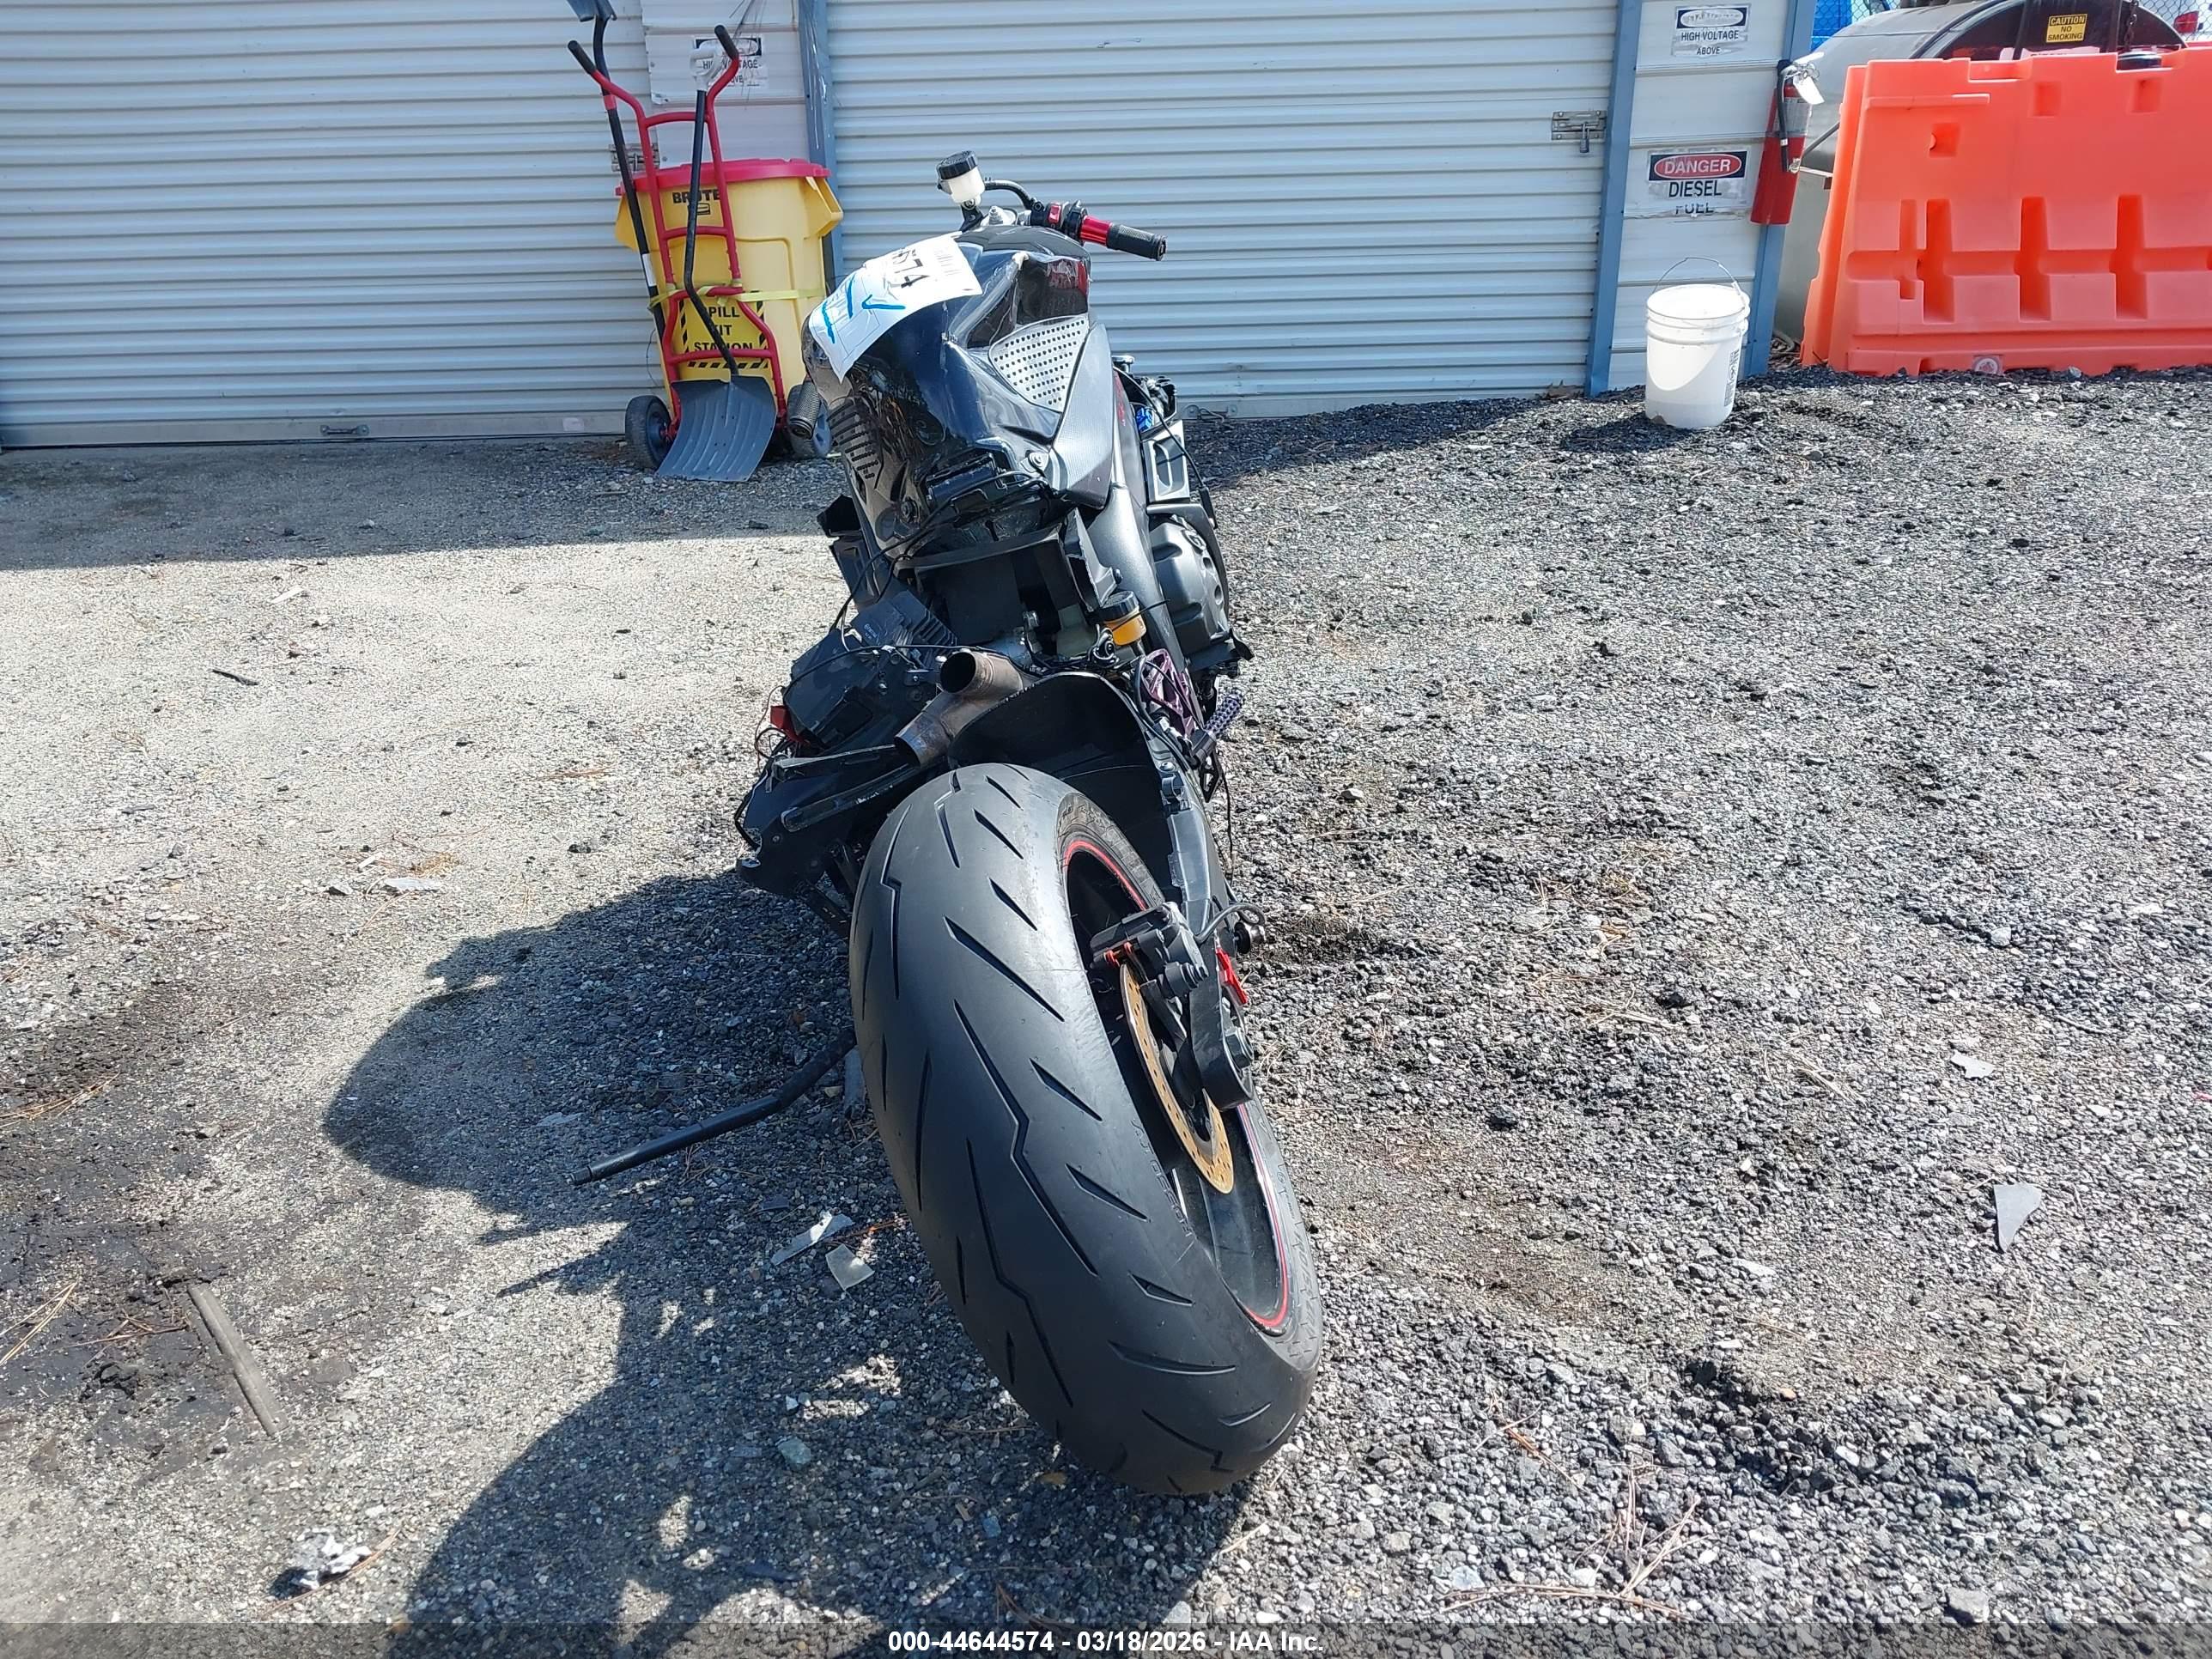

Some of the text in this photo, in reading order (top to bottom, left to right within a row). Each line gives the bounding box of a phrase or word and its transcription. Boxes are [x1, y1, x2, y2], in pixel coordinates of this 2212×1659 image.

[2051, 15, 2085, 25] CAUTION
[1681, 30, 1739, 41] HIGH VOLTAGE
[2047, 33, 2082, 41] SMOKING
[1696, 46, 1721, 55] ABOVE
[1664, 159, 1731, 174] DANGER
[1668, 179, 1722, 198] DIESEL
[704, 306, 739, 318] PILL
[694, 342, 752, 351] STAION
